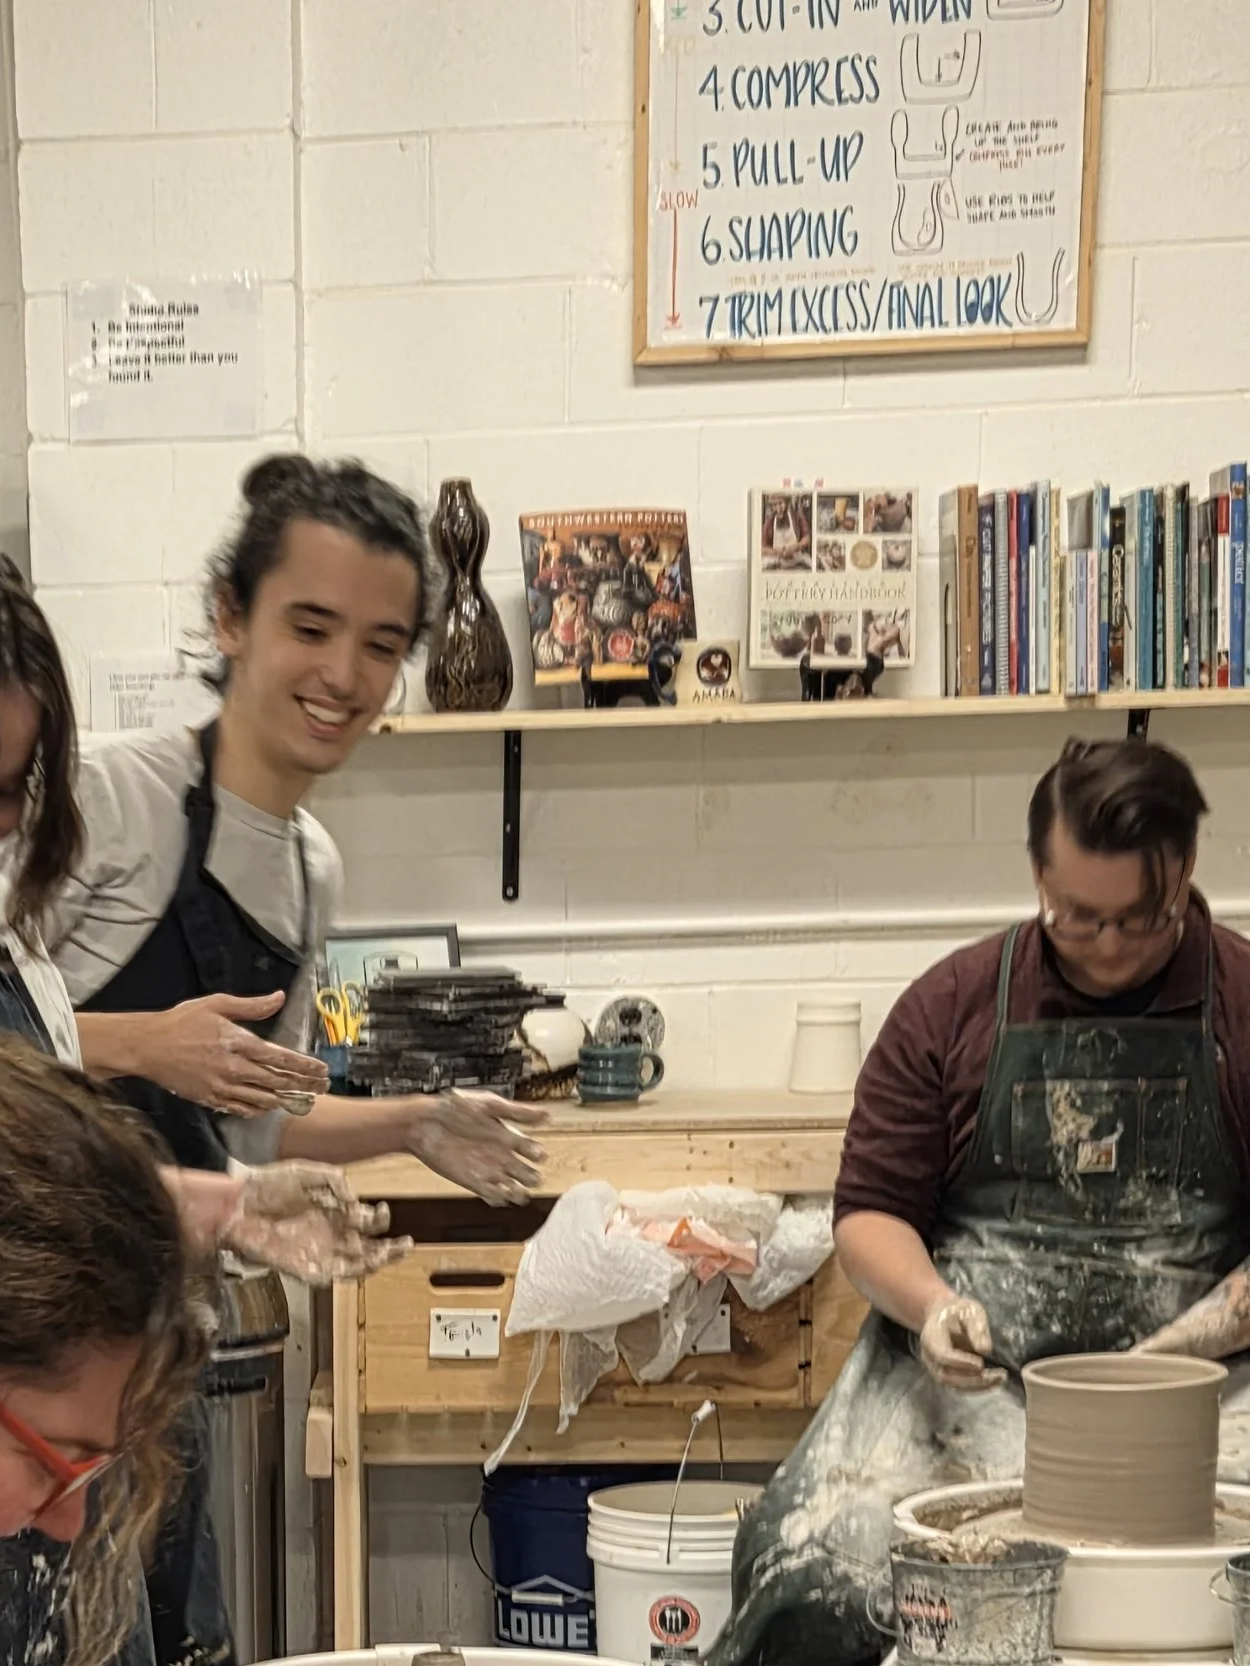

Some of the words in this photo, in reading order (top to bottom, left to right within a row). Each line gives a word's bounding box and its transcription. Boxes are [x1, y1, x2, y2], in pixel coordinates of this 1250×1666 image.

[731, 52, 880, 112] COMPRESS
[732, 129, 865, 188] PULL-UP
[659, 189, 699, 211] SLOW
[729, 204, 858, 263] SHAPING
[724, 286, 783, 341] TRIM
[956, 271, 1014, 328] LOOK
